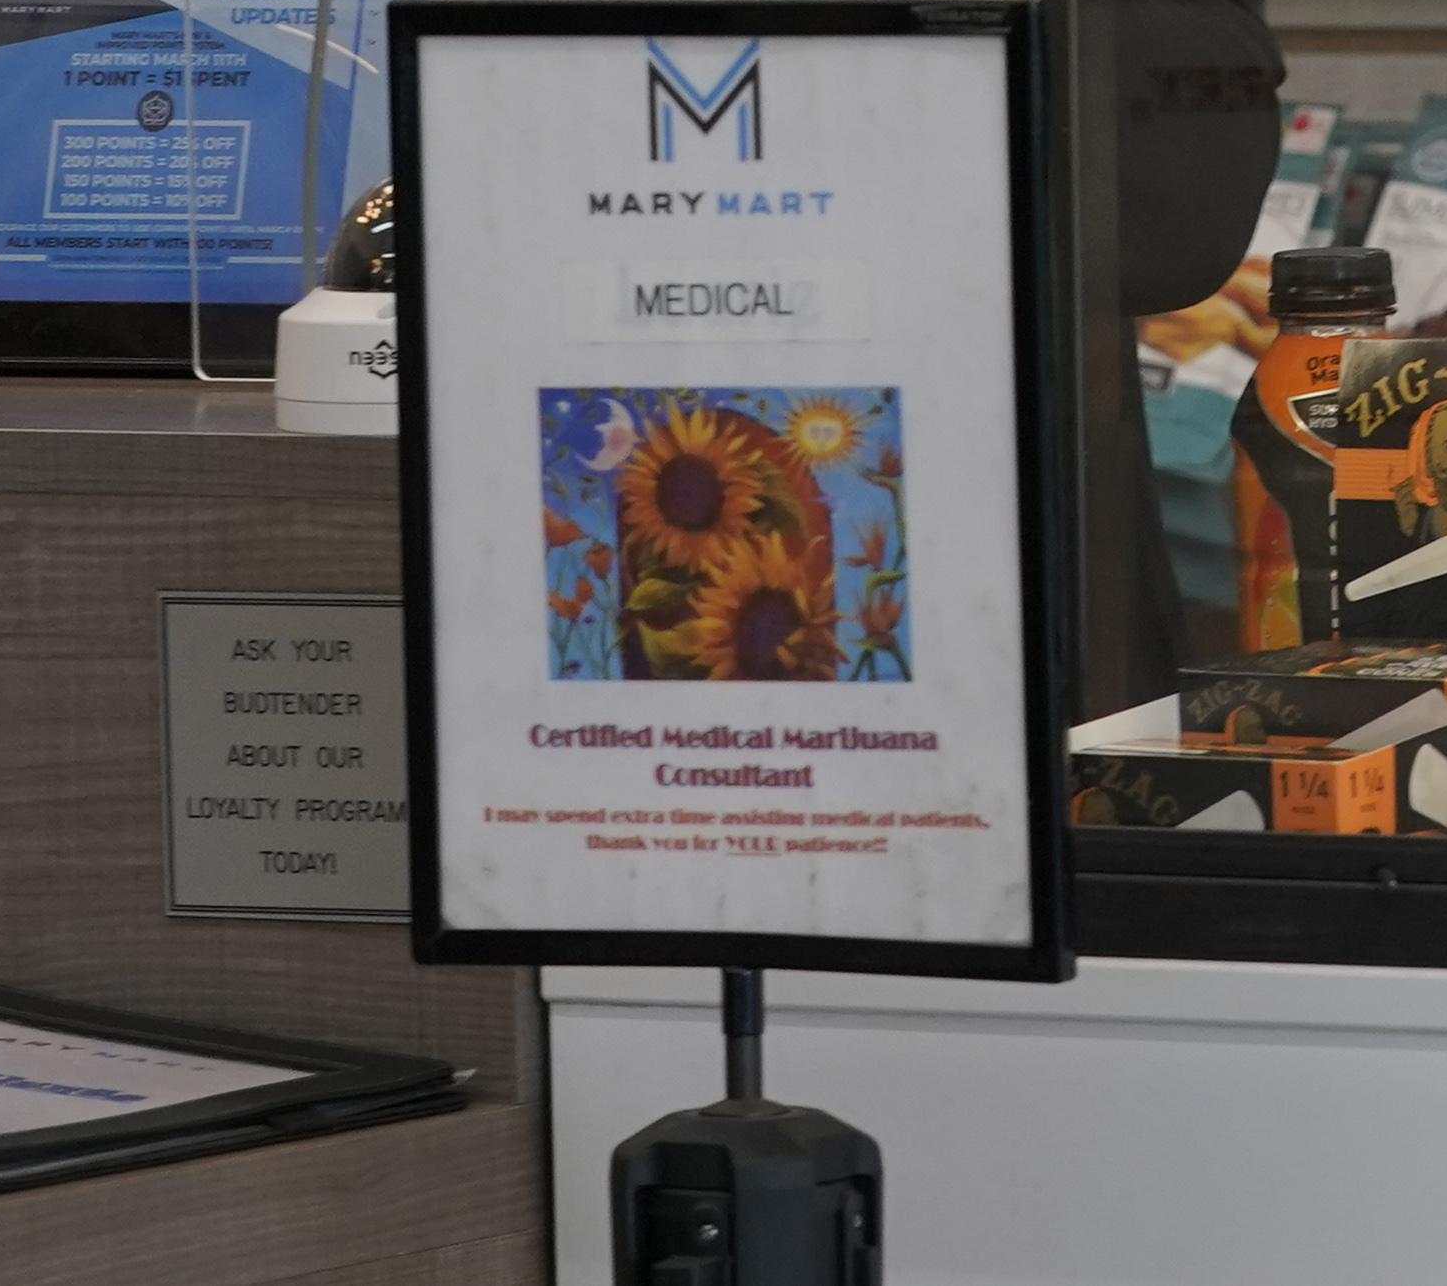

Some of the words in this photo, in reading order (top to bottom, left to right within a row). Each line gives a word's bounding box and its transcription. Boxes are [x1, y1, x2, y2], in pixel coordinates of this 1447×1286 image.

[70, 52, 149, 67] STARTING
[76, 70, 140, 87] POINT
[96, 136, 154, 151] POINTS
[204, 136, 237, 151] OFF
[93, 155, 154, 170] POINTS
[202, 155, 235, 170] OFF
[92, 174, 153, 189] POINTS
[196, 174, 228, 189] OFF
[89, 193, 151, 209] POINTS
[195, 193, 228, 209] OFF
[588, 190, 707, 216] MARY
[717, 190, 836, 216] MART
[634, 282, 794, 318] MEDICAL
[230, 638, 277, 662] ASK
[291, 639, 353, 663] YOUR
[222, 691, 364, 716] BUDTENDER
[529, 724, 653, 750] Certified
[661, 725, 773, 750] Medical
[781, 726, 939, 754] Marijuana
[226, 744, 303, 768] ABOUT
[316, 745, 365, 770] OUR
[654, 763, 814, 790] Consultant
[186, 796, 281, 820] LOYALTY
[295, 798, 405, 823] PROGRAM
[544, 807, 607, 827] spend
[610, 808, 665, 825] extra
[670, 807, 717, 825] time
[720, 808, 808, 829] assisting
[810, 808, 897, 827] medical
[653, 836, 688, 855] you
[691, 834, 720, 852] for
[259, 849, 339, 874] TODAY!
